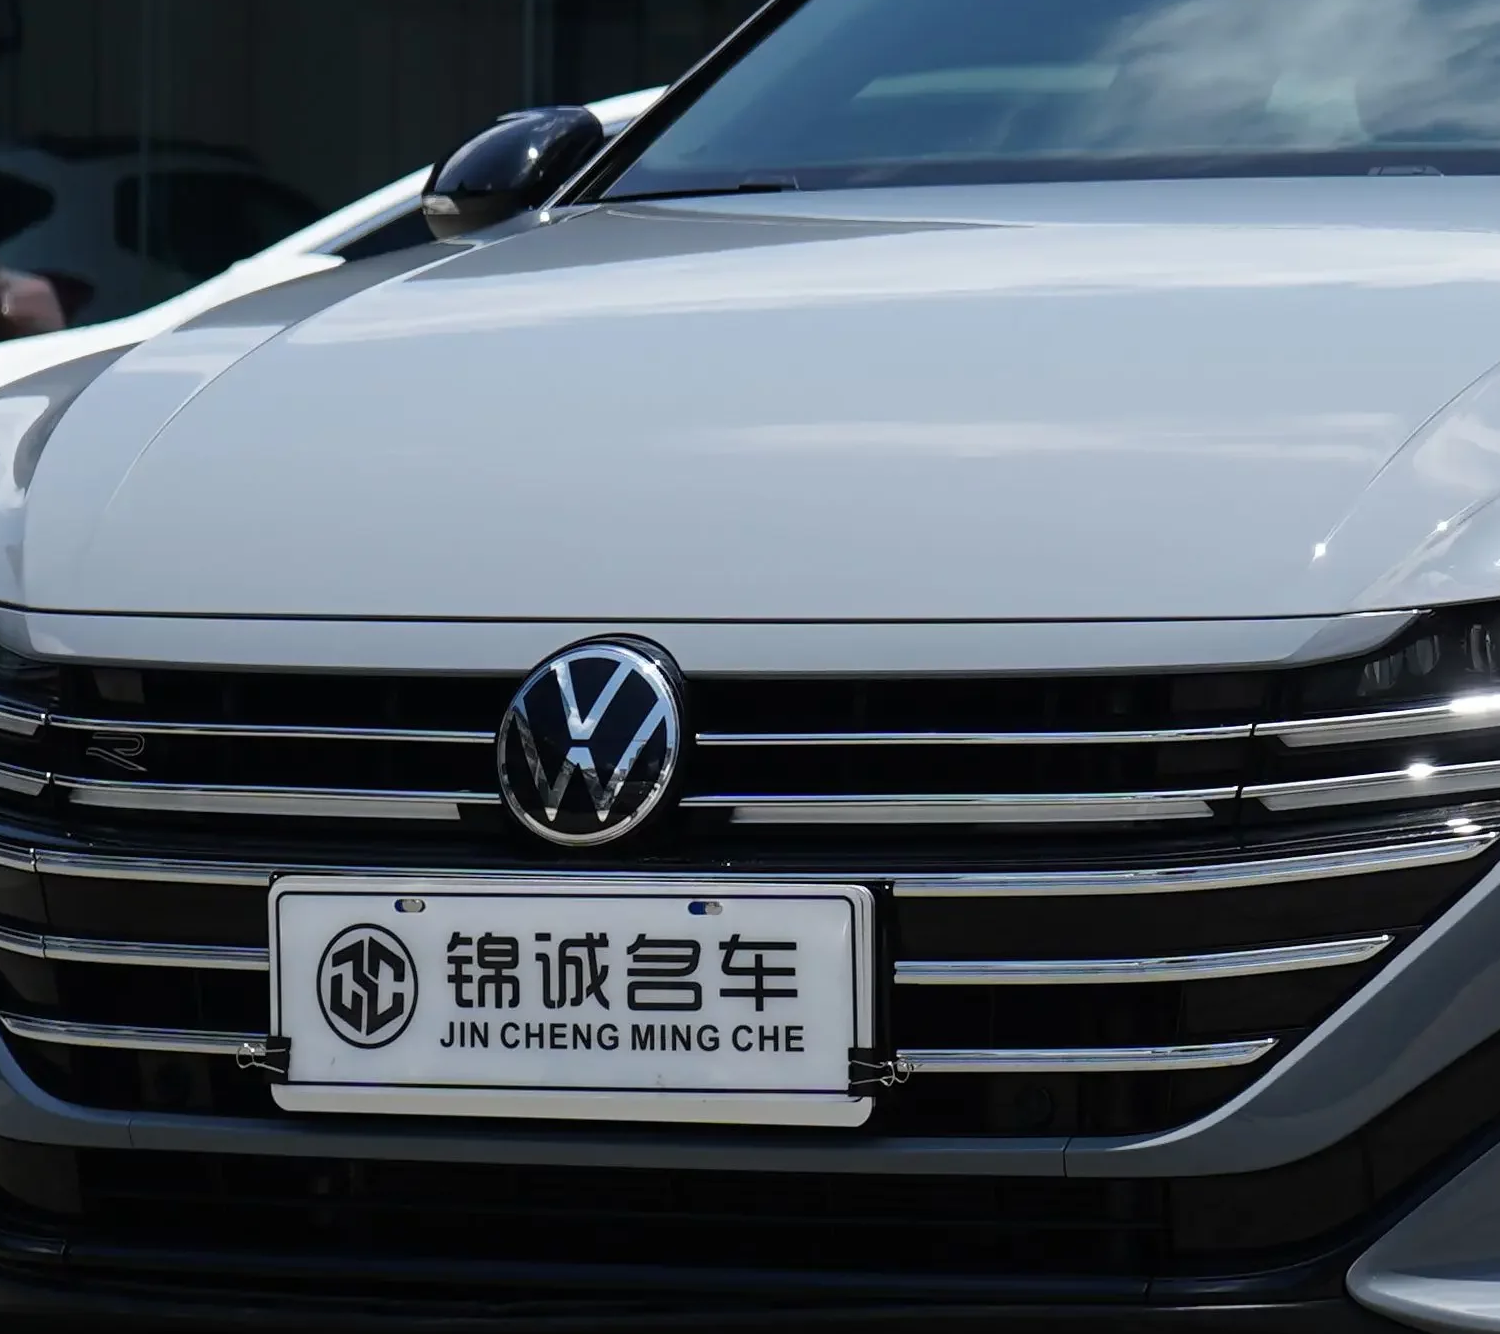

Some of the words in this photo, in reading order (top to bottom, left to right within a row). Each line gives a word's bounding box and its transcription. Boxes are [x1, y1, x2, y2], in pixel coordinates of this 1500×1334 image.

[446, 931, 799, 1012] 锦诚名车
[439, 1020, 490, 1049] JIN
[500, 1021, 620, 1051] CHENG
[631, 1023, 721, 1053] MING
[731, 1024, 805, 1053] CHE
